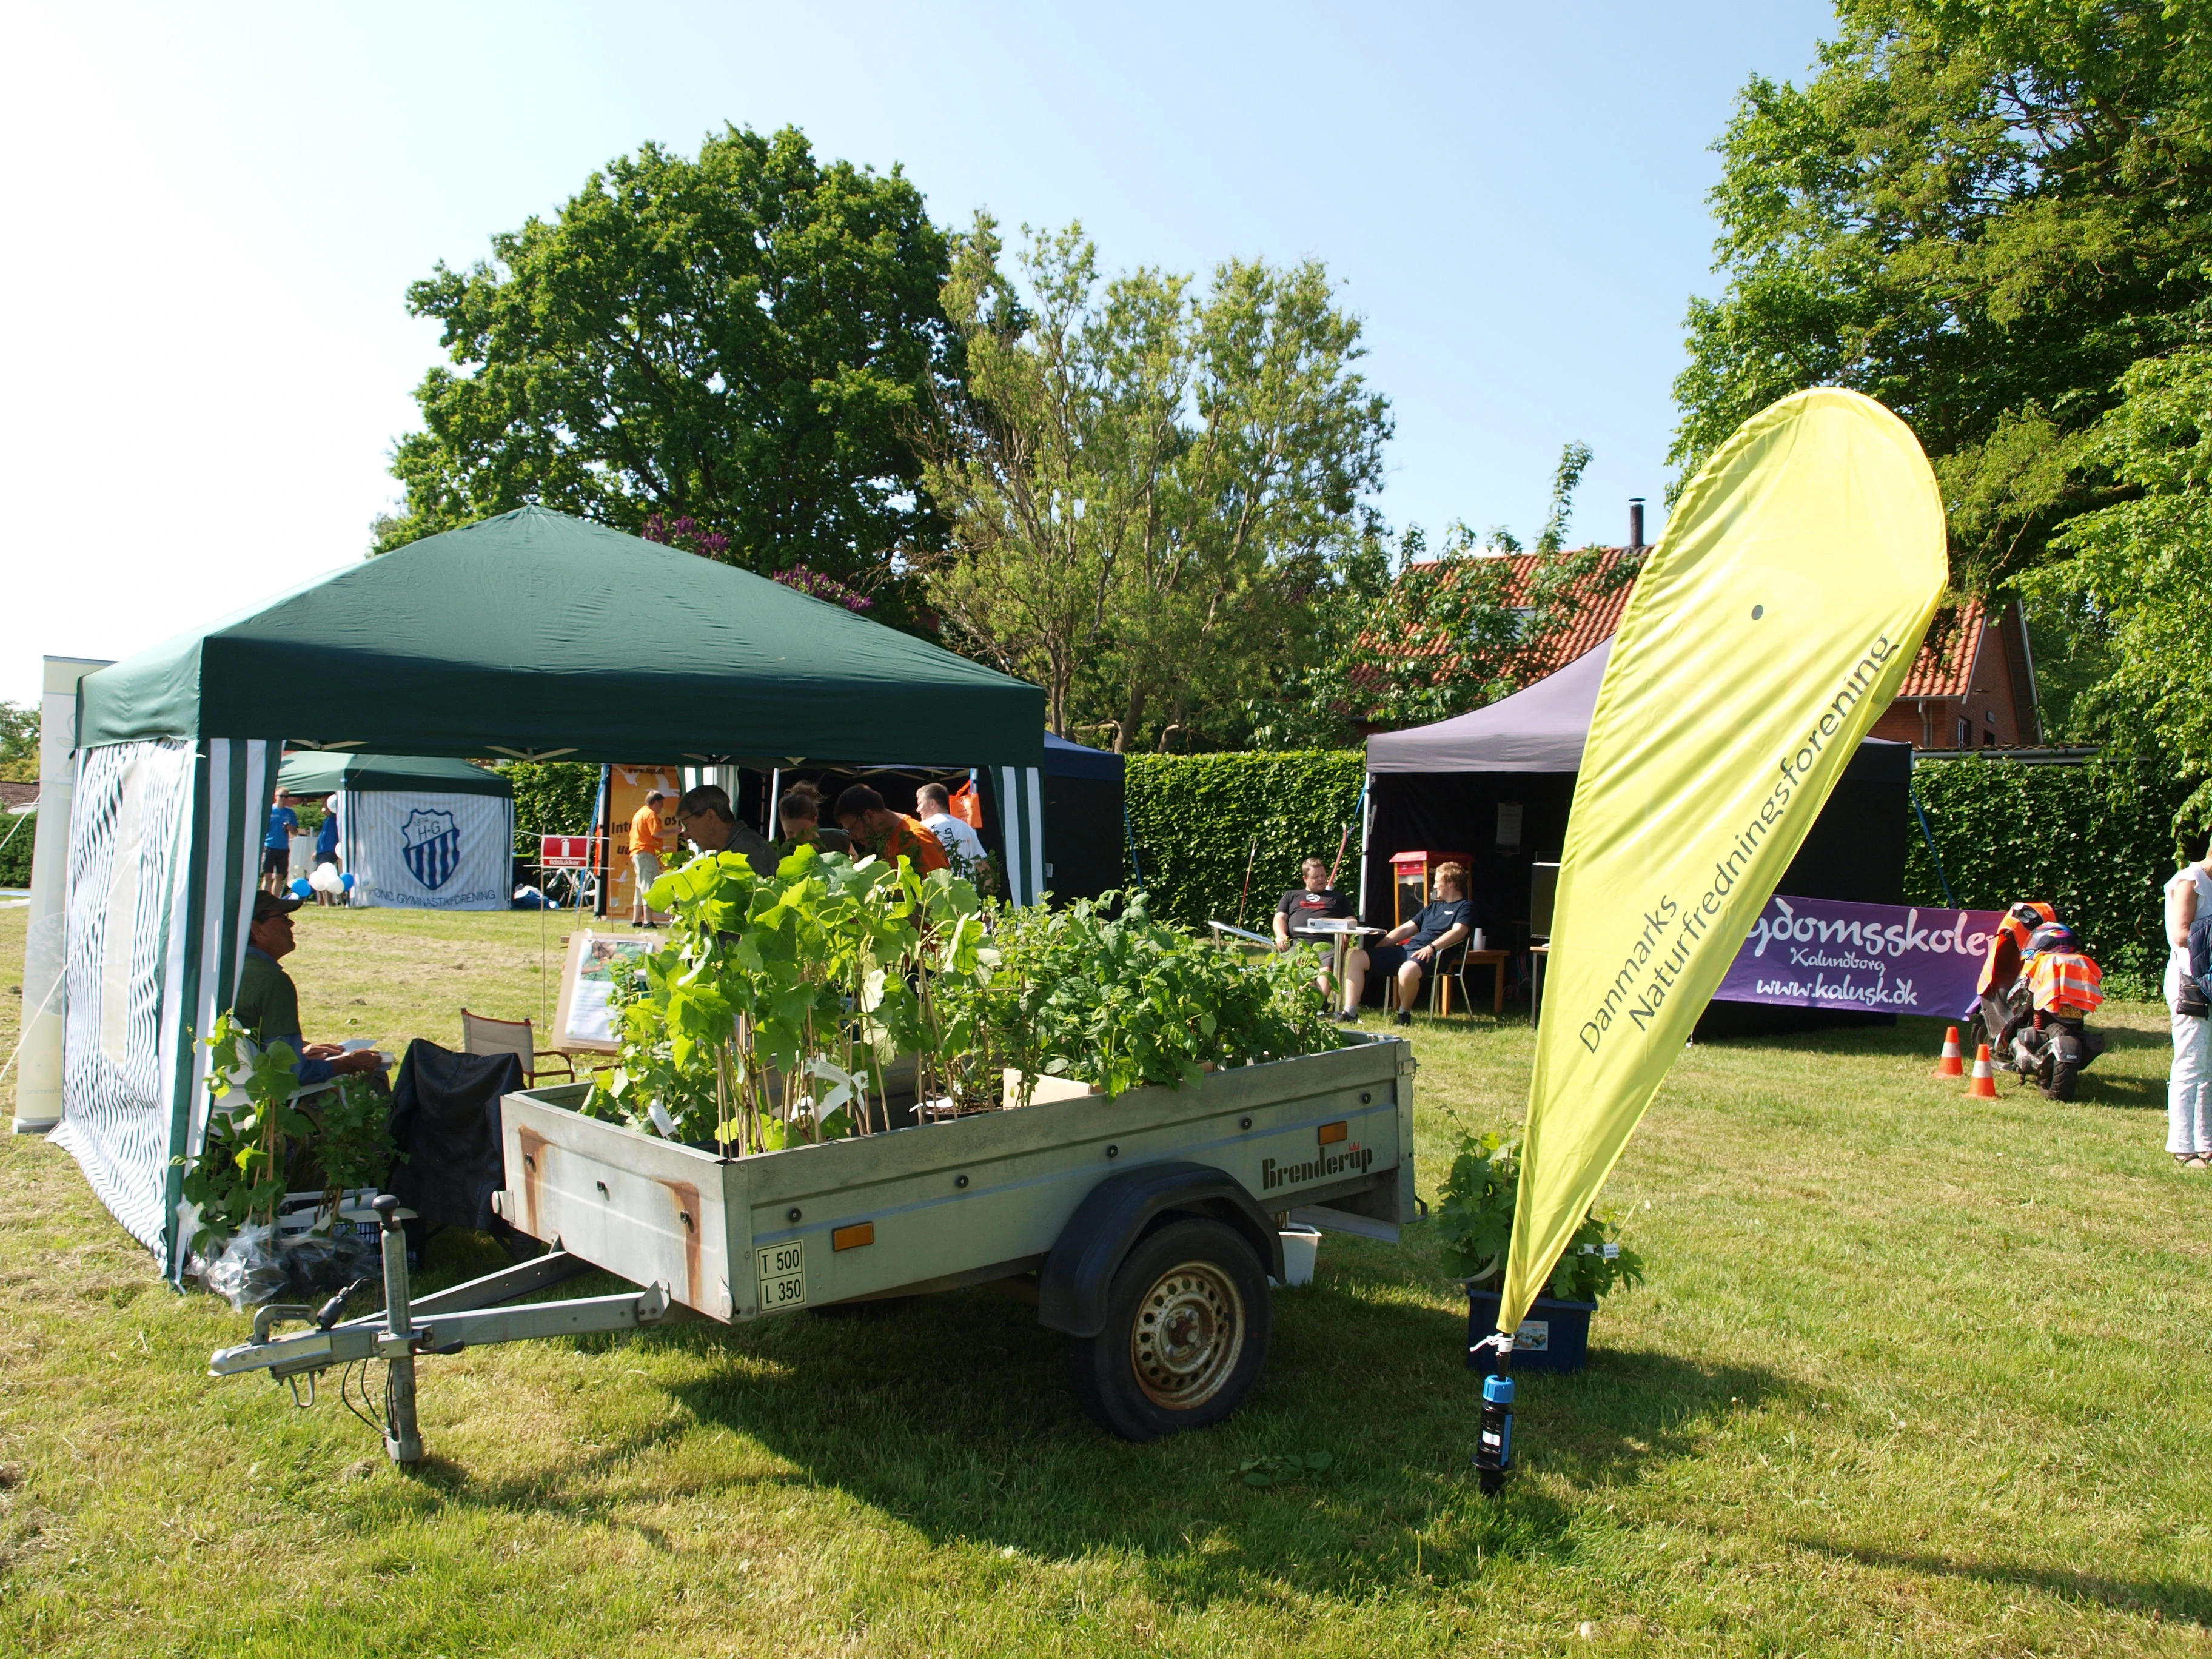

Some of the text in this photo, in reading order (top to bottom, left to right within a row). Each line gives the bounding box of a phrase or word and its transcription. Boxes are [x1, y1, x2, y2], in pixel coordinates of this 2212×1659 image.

[1629, 632, 1900, 1032] Naturfredningsforening
[396, 890, 496, 907] GYMNASTIKFORENING
[1578, 894, 1678, 1054] Danmarks
[1790, 947, 1886, 976] Kalundborg
[1756, 973, 1918, 1007] www.kalusk.dk
[1262, 1146, 1373, 1190] Brenderup
[761, 1248, 800, 1273] T 500
[765, 1279, 801, 1304] L 350
